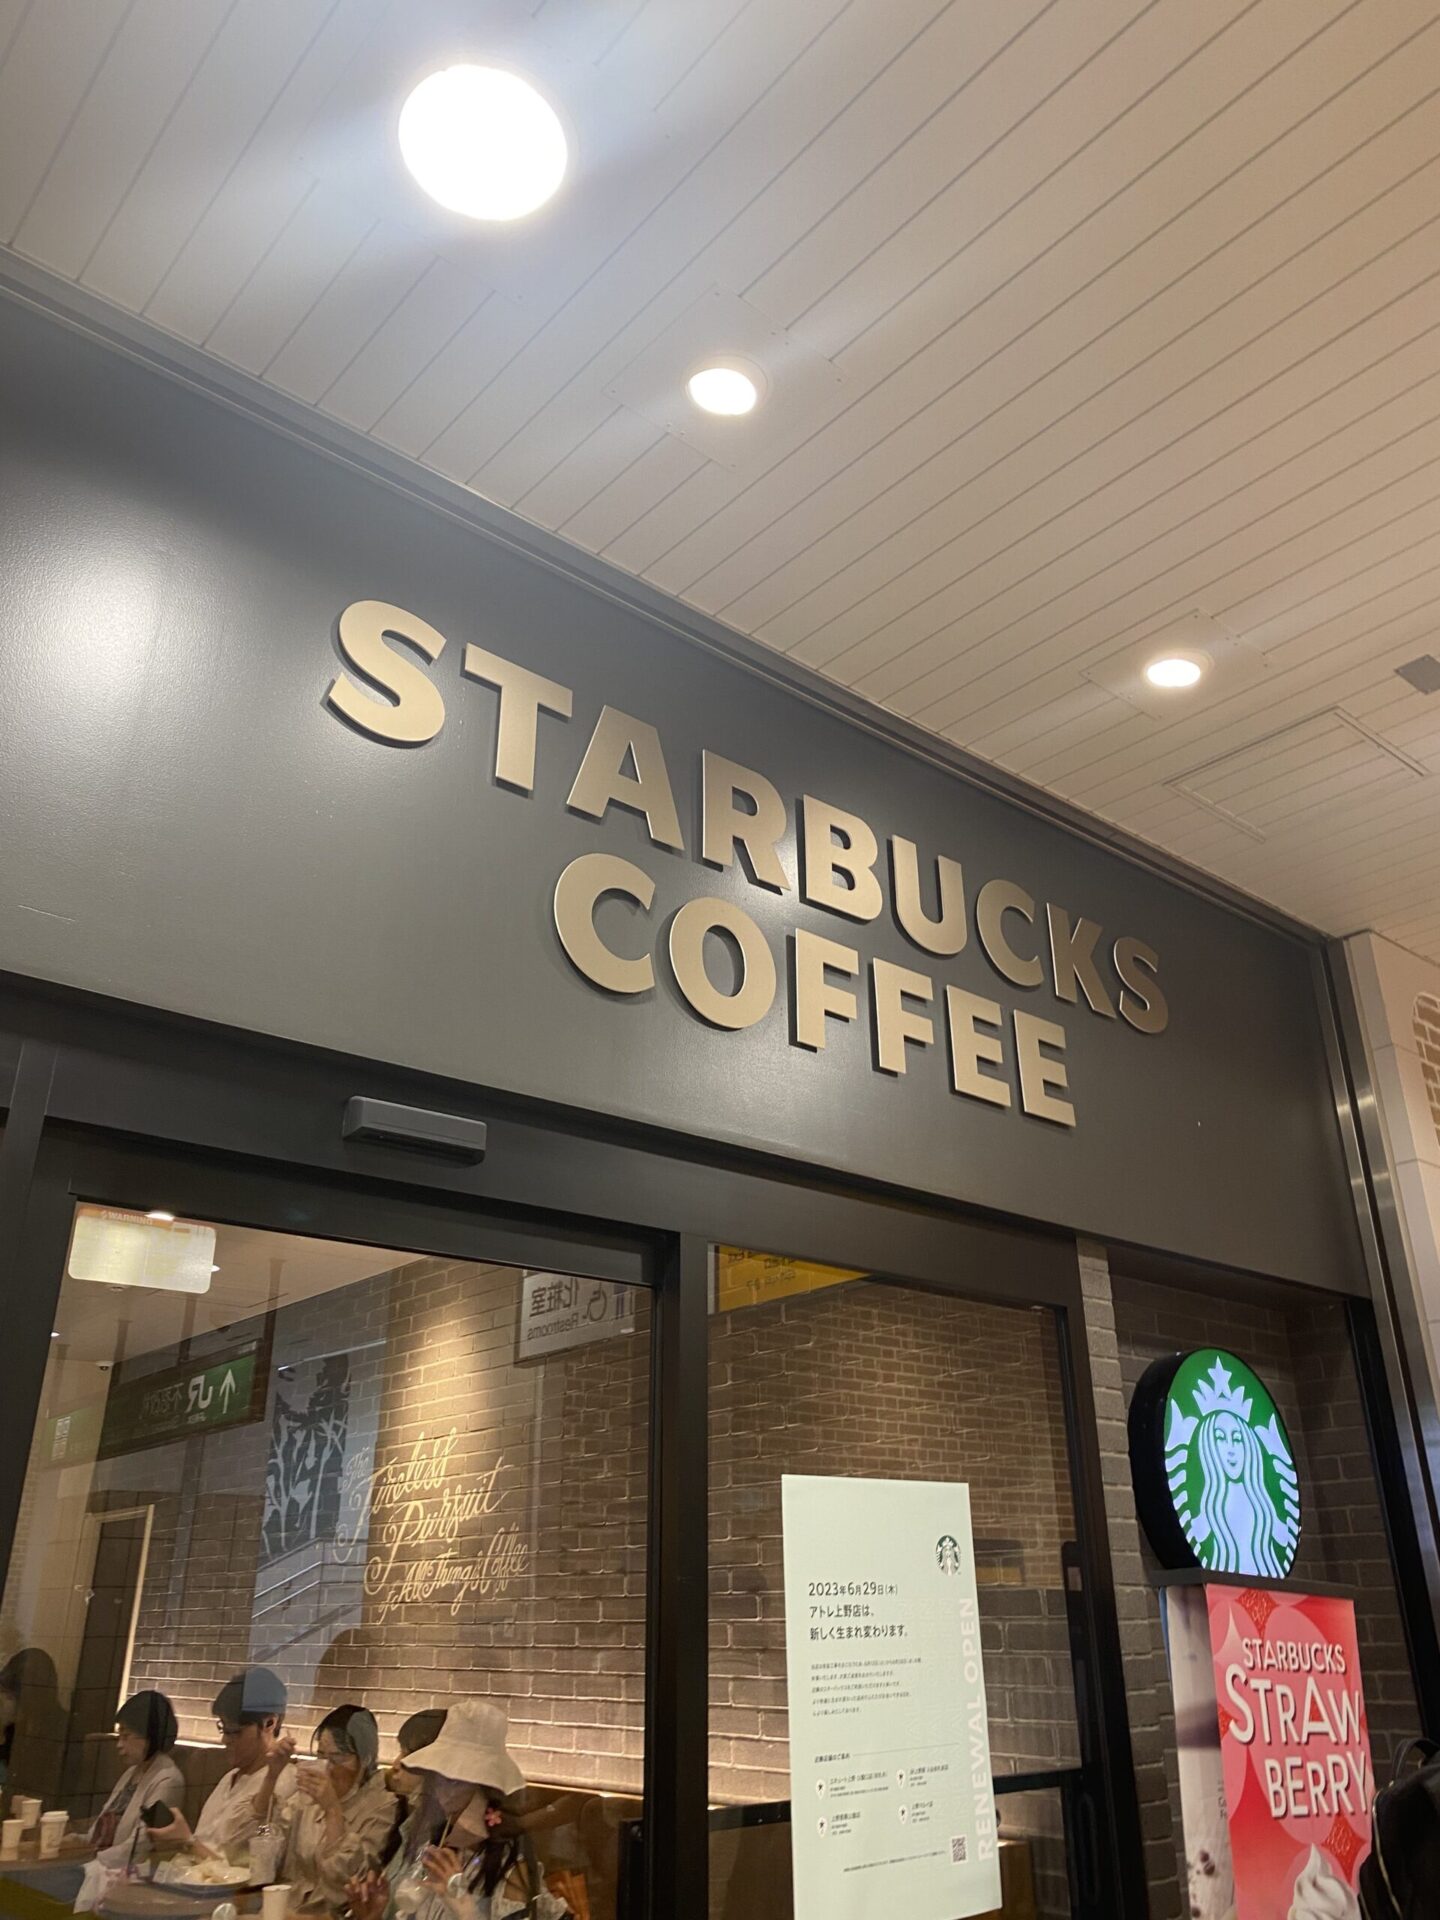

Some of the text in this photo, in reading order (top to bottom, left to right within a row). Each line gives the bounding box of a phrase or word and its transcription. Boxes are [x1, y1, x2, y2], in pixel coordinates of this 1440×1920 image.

[327, 599, 1169, 1034] STARBUCKS
[551, 852, 1077, 1128] COFFEE
[364, 1456, 515, 1595] Pursuit
[479, 1522, 531, 1594] Coffee
[810, 1624, 908, 1641] 新しく生まれ変わります。
[1241, 1637, 1348, 1675] STARBUCKS
[959, 1598, 995, 1862] RENEWAL OPEN
[1224, 1663, 1362, 1746] STRAW
[1263, 1751, 1370, 1818] BERRY
